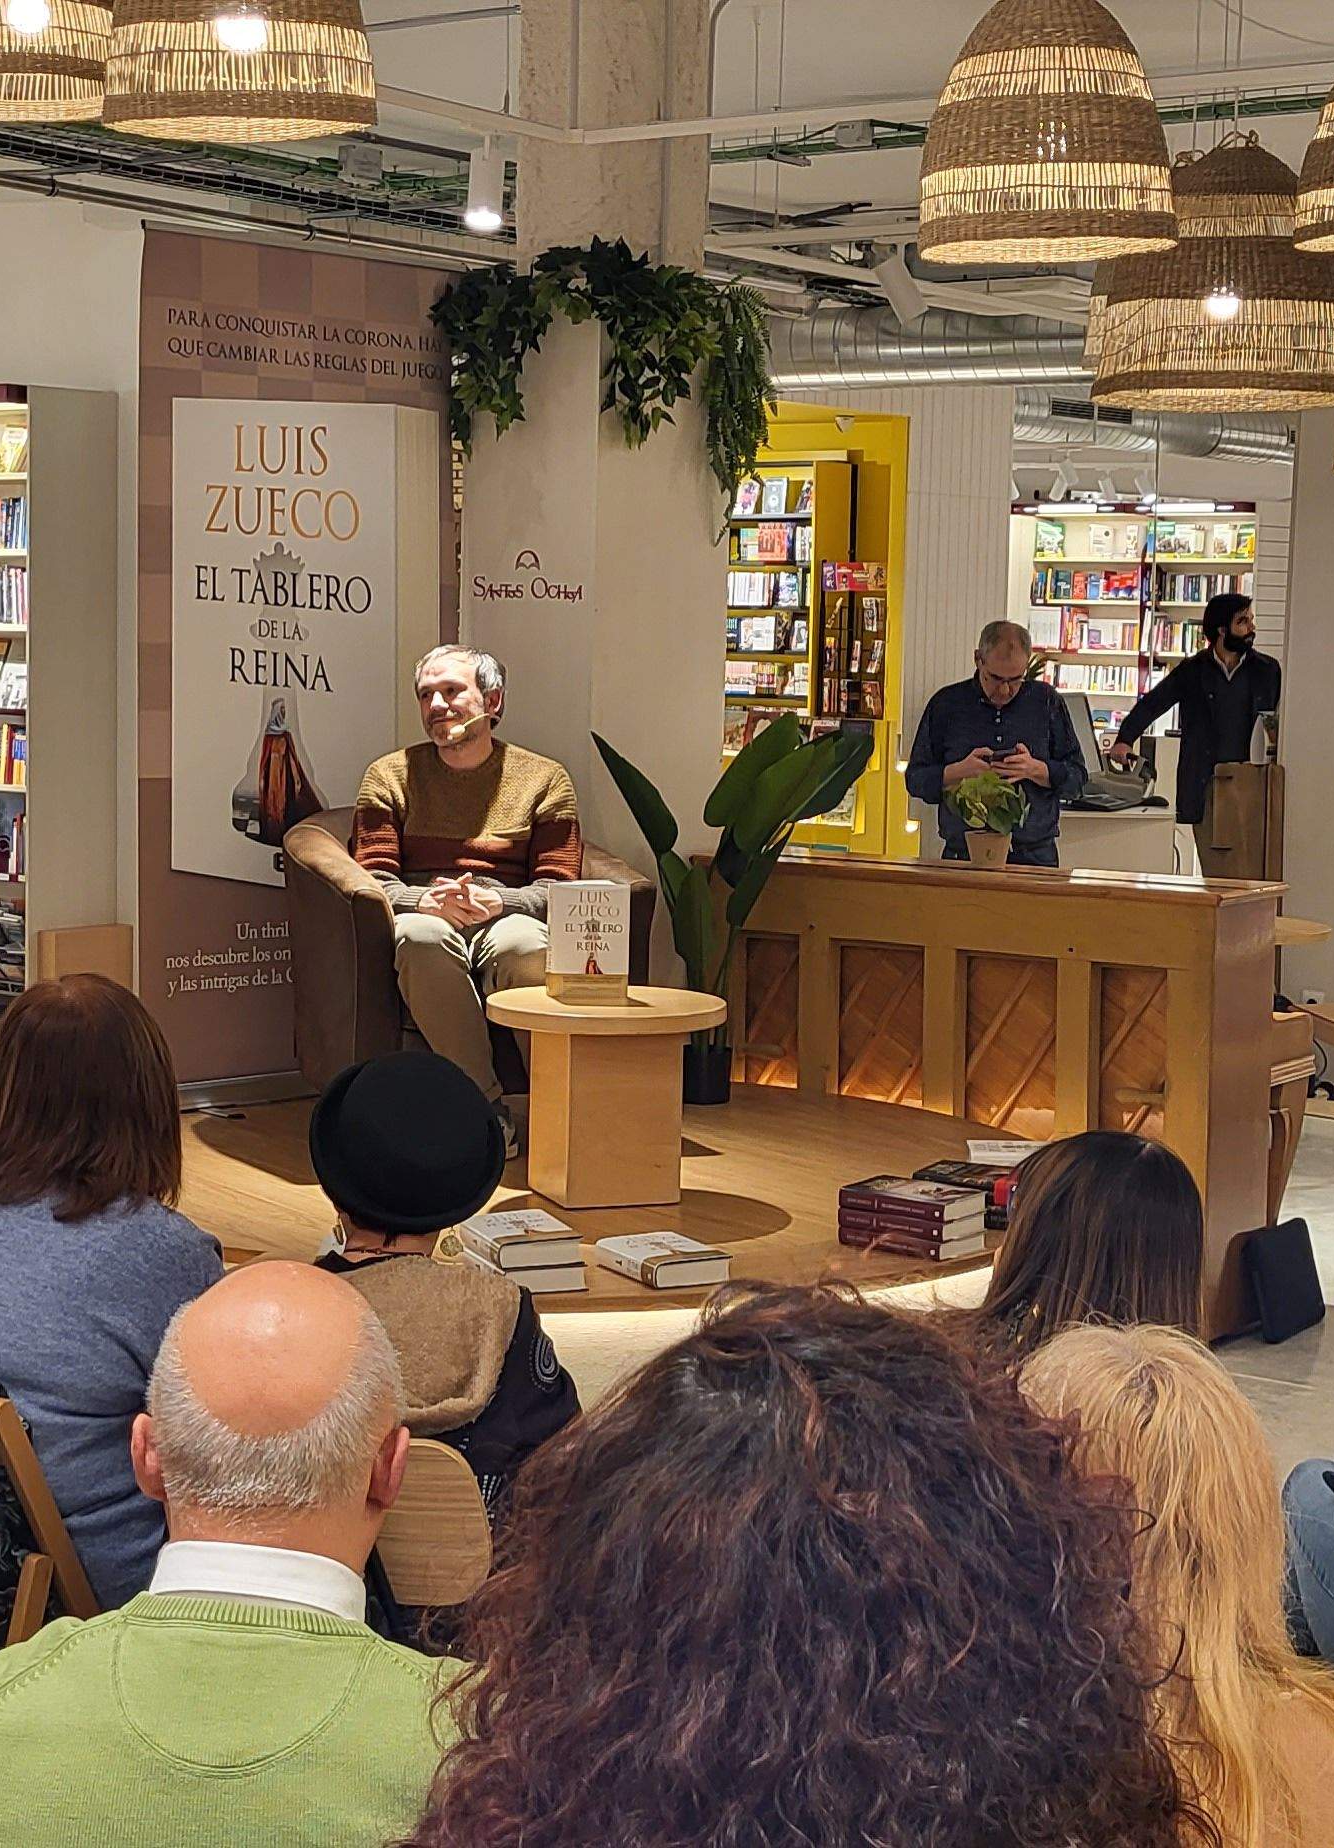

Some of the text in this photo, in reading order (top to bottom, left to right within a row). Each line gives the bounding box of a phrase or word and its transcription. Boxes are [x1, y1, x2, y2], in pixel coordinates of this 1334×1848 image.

[168, 308, 210, 328] PARA
[215, 314, 318, 340] CONQUISTAR
[323, 326, 340, 343] LA
[168, 338, 443, 380] QUE CAMBIAR LAS REGLAS DEL JUEGO
[235, 424, 328, 476] LUIS
[204, 484, 360, 541] ZUECO
[195, 564, 372, 614] EL TABLERO
[257, 619, 304, 641] DE LA
[229, 647, 334, 692] REINA
[580, 890, 610, 903] LUIS
[568, 904, 620, 917] ZUECO
[236, 922, 258, 940] Un
[565, 922, 623, 933] EL TABLERO
[167, 956, 189, 969] nos
[192, 947, 250, 967] descubre
[252, 946, 271, 962] los
[576, 941, 610, 951] REINA
[168, 980, 177, 998] y
[180, 974, 198, 992] las
[201, 972, 250, 993] intrigas
[252, 968, 268, 986] de
[271, 968, 283, 984] la
